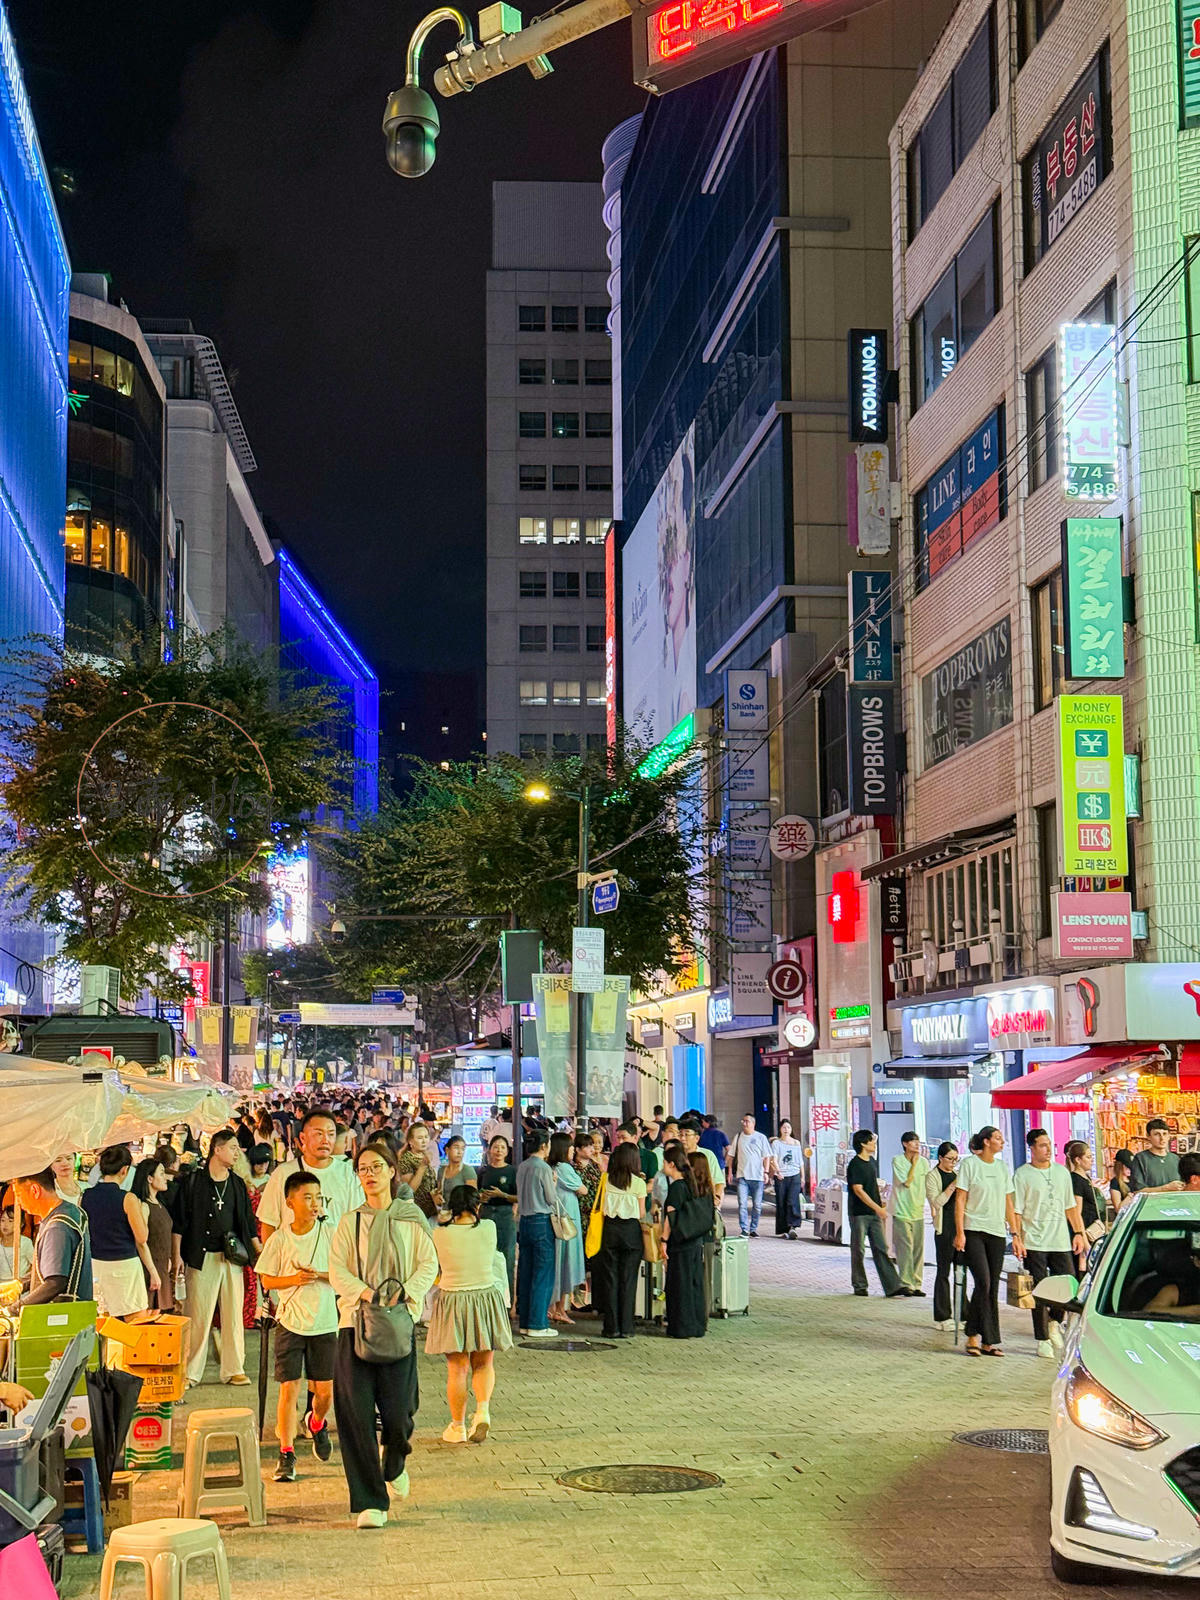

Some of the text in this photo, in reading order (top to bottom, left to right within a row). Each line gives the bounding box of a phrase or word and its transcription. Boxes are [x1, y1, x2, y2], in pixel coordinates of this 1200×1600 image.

[1046, 91, 1096, 201] 부동산
[1049, 163, 1096, 240] 774-5488
[862, 336, 877, 431] TONYMOLY
[1071, 356, 1113, 457] 부동산
[967, 428, 991, 475] 라인
[1068, 466, 1115, 480] 774-
[932, 468, 956, 513] LINE
[1067, 482, 1117, 495] 5488
[864, 576, 882, 659] LINE
[932, 621, 1008, 703] TOPBROWS
[865, 669, 882, 681] 4F
[731, 703, 764, 711] Shinhan
[1073, 702, 1111, 712] MONEY
[1066, 714, 1117, 724] EXCHANGE
[862, 696, 886, 806] TOPBROWS
[1080, 765, 1106, 785] 元
[778, 822, 808, 853] 藥
[1080, 827, 1111, 849] HK$
[1074, 859, 1117, 871] 고래환전
[1062, 915, 1128, 926] LENS TOWN
[793, 1025, 807, 1041] 약
[911, 1014, 967, 1043] TONYMOLY
[464, 1087, 481, 1095] SIM
[878, 1088, 913, 1096] TONYMOLY
[813, 1103, 840, 1131] 藥
[144, 1375, 174, 1386] 마토케찹
[117, 1488, 125, 1499] 5
